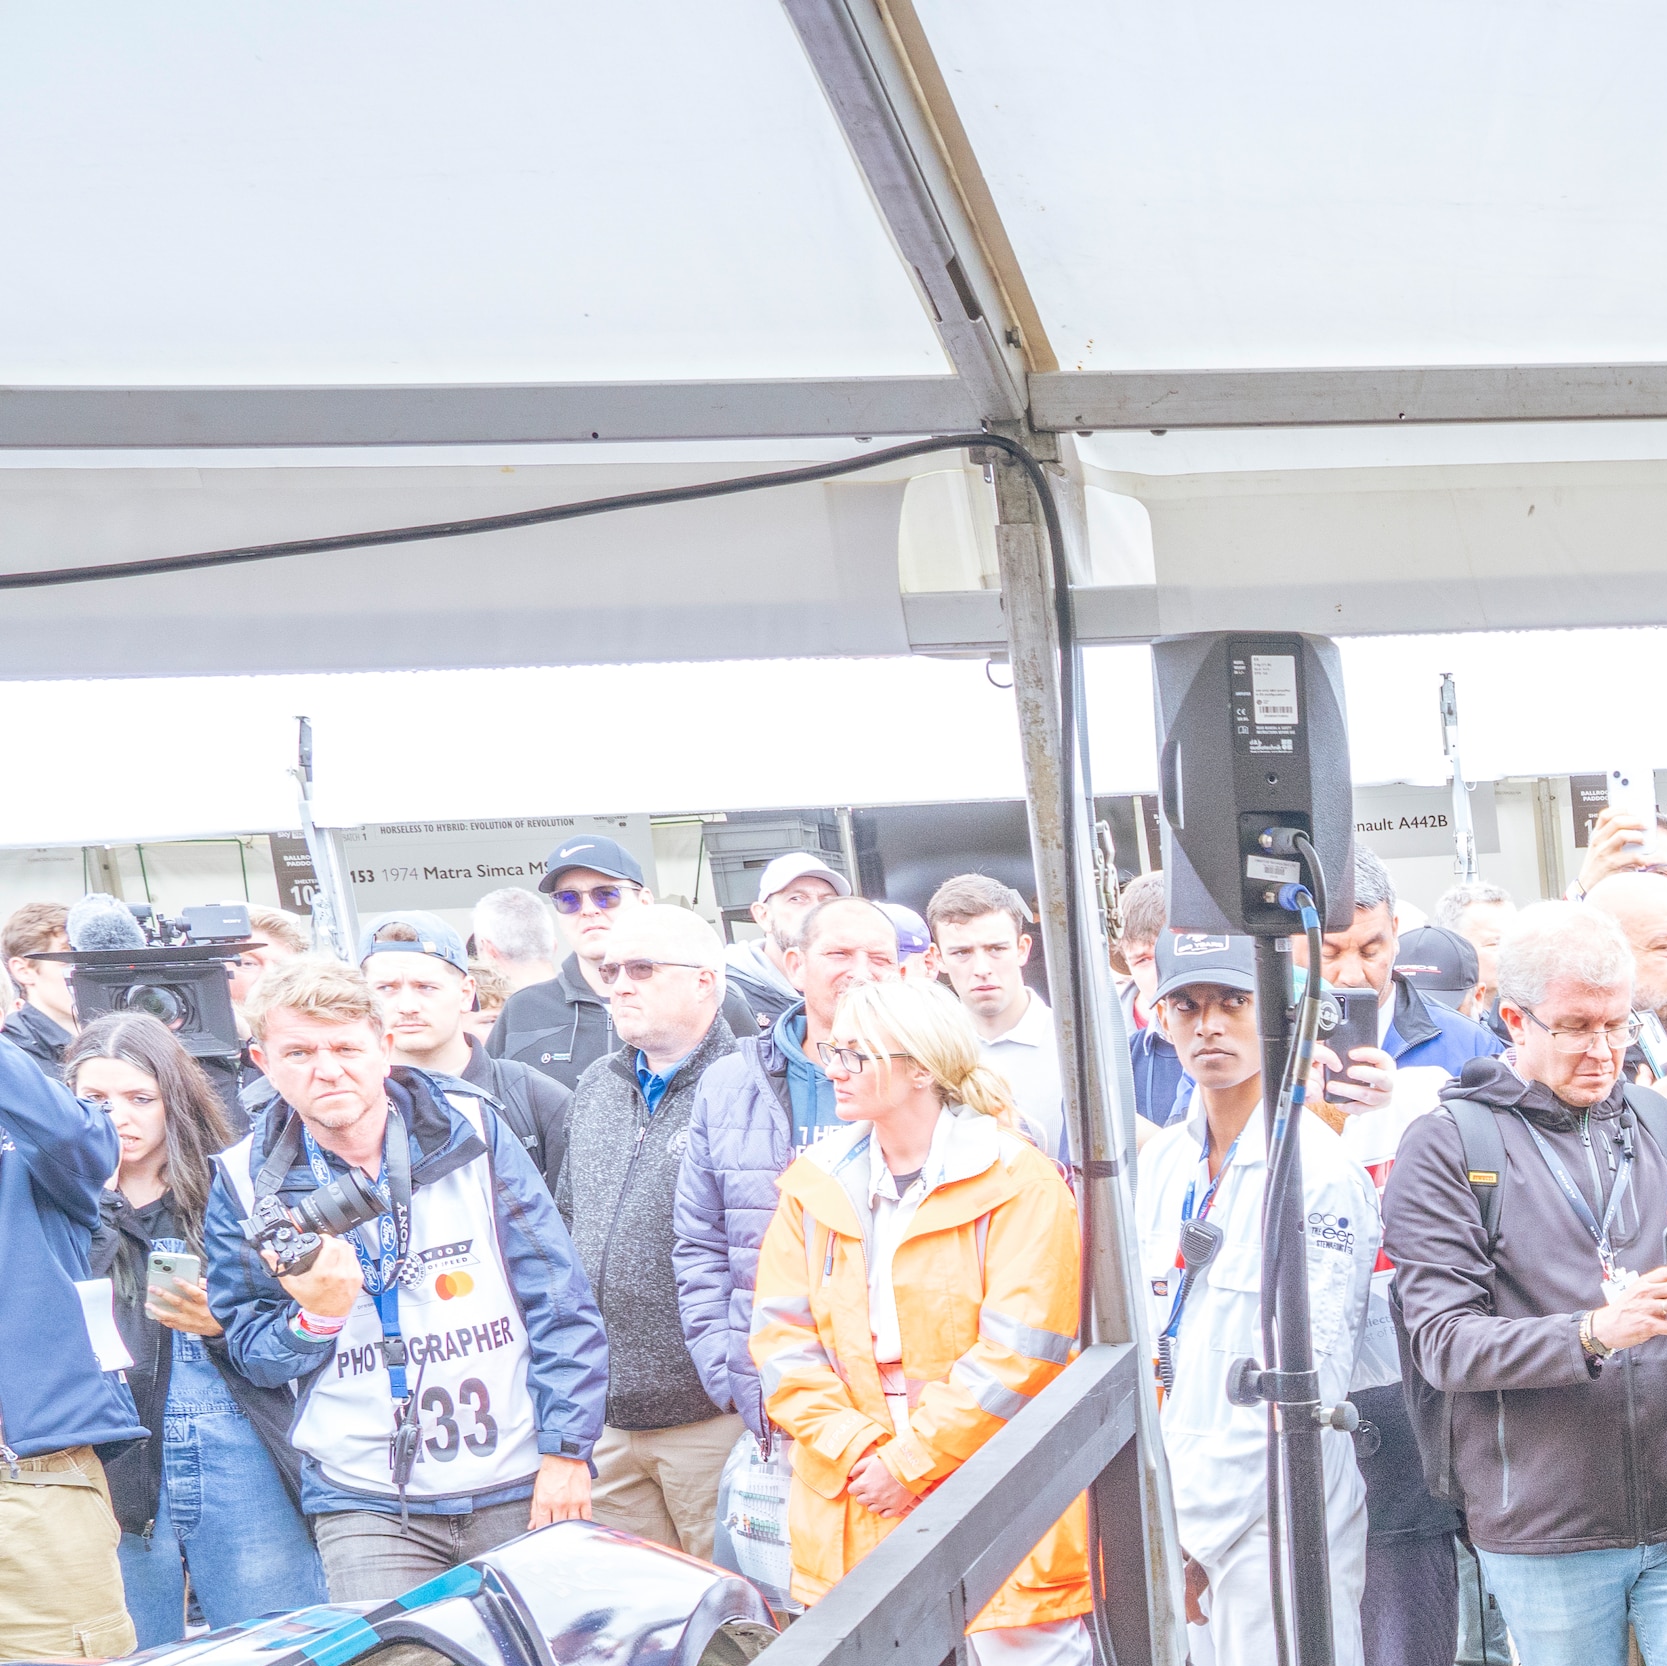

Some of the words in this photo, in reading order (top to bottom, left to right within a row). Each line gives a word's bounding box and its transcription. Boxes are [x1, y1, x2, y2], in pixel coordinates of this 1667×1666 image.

[380, 824, 422, 835] HORSELESS
[423, 823, 434, 833] TO
[436, 821, 468, 832] HYBRID:
[470, 820, 512, 832] EVOLUTION
[514, 819, 525, 830] OF
[526, 817, 575, 829] REVOLUTION
[1398, 814, 1449, 830] A442B
[362, 833, 367, 841] 1
[350, 869, 375, 883] 153
[381, 867, 419, 882] 1974
[423, 864, 472, 881] Matra
[476, 861, 525, 878] Simca
[290, 884, 320, 907] 10
[1556, 1169, 1578, 1200] ALPINE
[396, 1202, 409, 1254] SONY
[337, 1316, 515, 1379] PHOGRAPHER
[414, 1377, 499, 1463] 33
